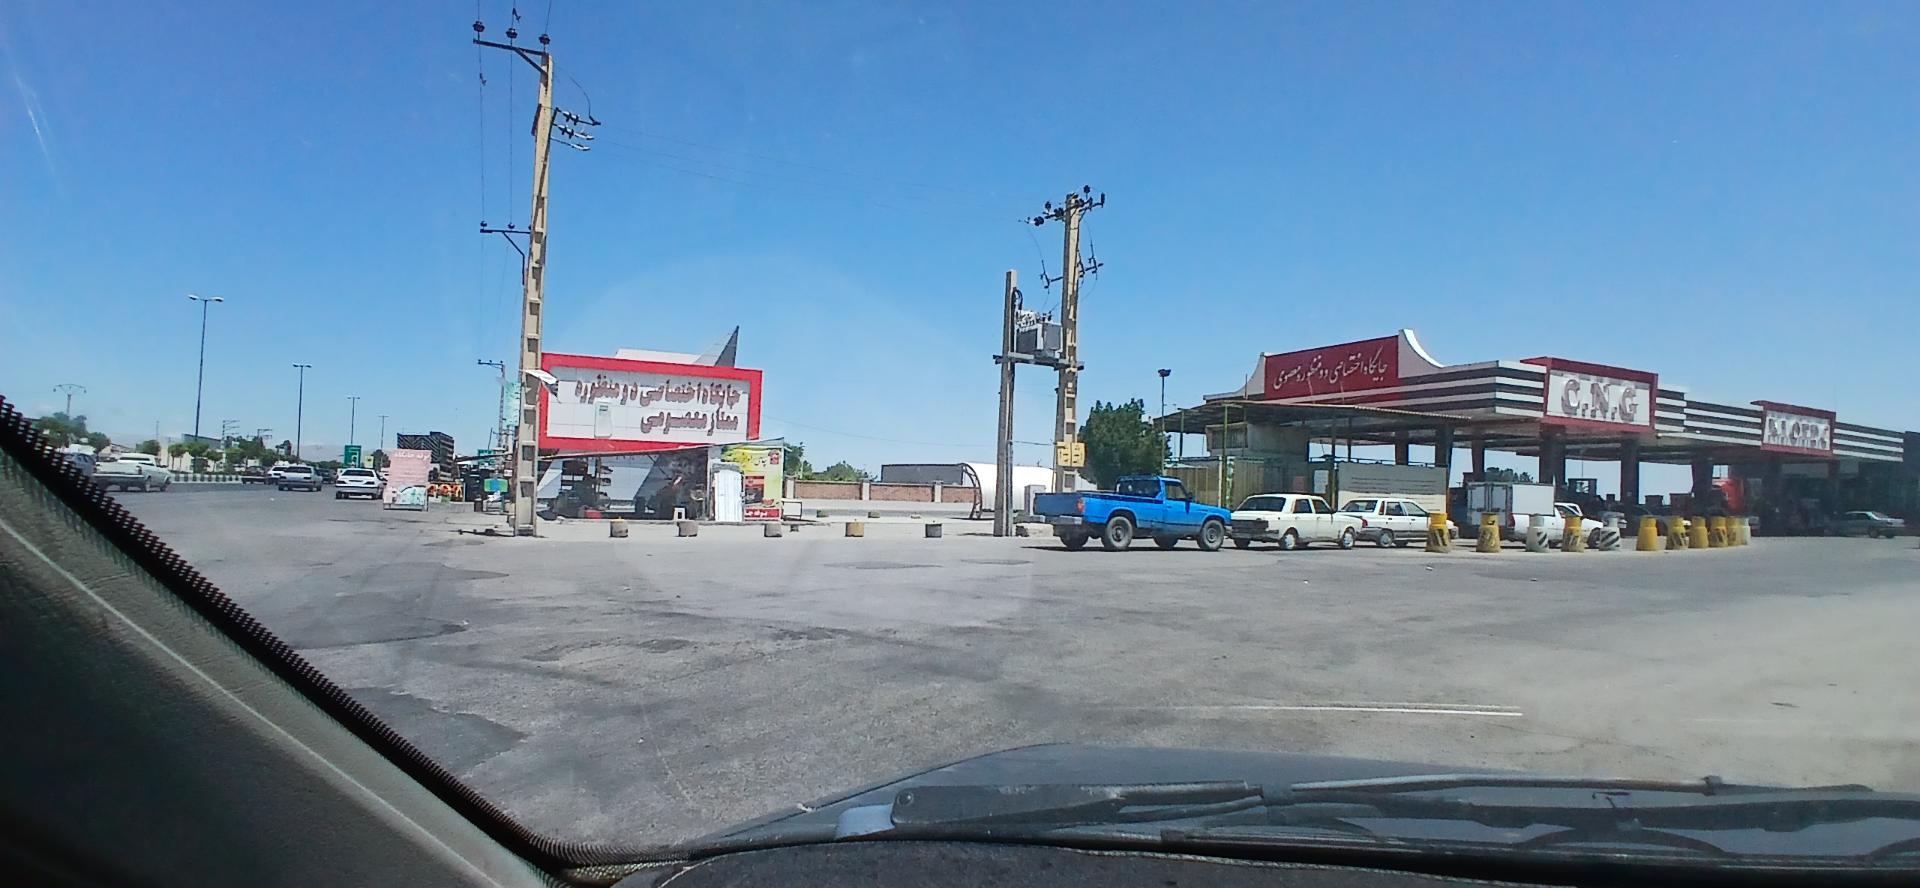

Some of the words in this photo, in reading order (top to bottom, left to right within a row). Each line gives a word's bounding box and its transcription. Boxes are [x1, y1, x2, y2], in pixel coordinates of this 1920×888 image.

[1329, 353, 1364, 383] اختصاصی
[1364, 345, 1387, 381] جایگاه
[575, 375, 620, 404] منظوره
[620, 382, 638, 405] دو
[640, 380, 702, 407] اختصاصی
[702, 382, 740, 409] جایگاه
[1560, 379, 1639, 422] C.N.G
[641, 411, 707, 434] معصومی
